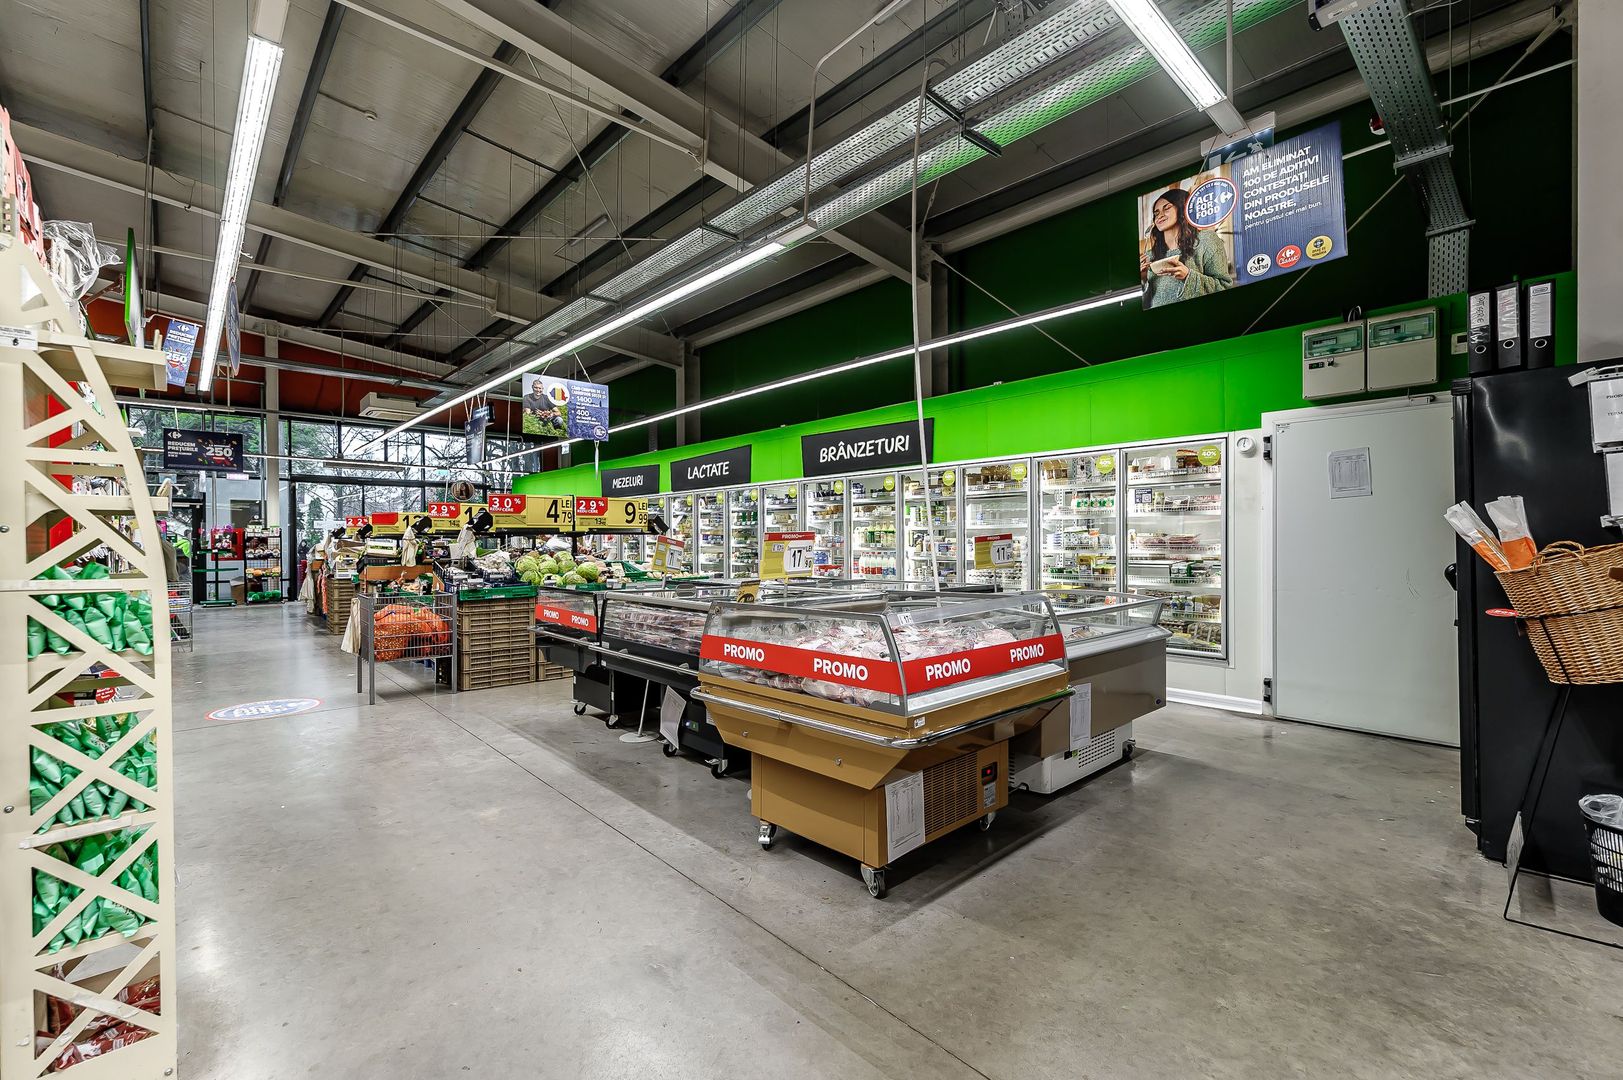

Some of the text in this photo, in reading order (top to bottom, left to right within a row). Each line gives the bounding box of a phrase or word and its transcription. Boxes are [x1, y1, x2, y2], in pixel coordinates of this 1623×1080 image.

[1243, 146, 1311, 178] AM ELIMINAT
[1244, 155, 1319, 188] 100 DE ADITIVI
[1196, 192, 1214, 205] ACT
[1244, 174, 1329, 210] DIN PRODUSELE
[1196, 201, 1213, 212] FOR
[1196, 205, 1220, 220] FOOD
[1244, 221, 1264, 231] pentru
[819, 435, 910, 463] BRÂNZETURI
[687, 461, 730, 479] LACTATE
[612, 475, 643, 488] MEZELURI
[546, 500, 560, 523] 4
[562, 500, 571, 508] LEI
[624, 502, 636, 524] 9
[639, 502, 648, 510] LEI
[562, 512, 572, 523] 79
[639, 514, 648, 525] 99
[791, 549, 803, 568] 17
[543, 609, 560, 619] PROMO
[571, 615, 589, 627] PROMO
[724, 643, 765, 662] PROMO
[1009, 643, 1045, 663] PROMO
[813, 657, 869, 681] PROMO
[925, 658, 971, 681] PROMO
